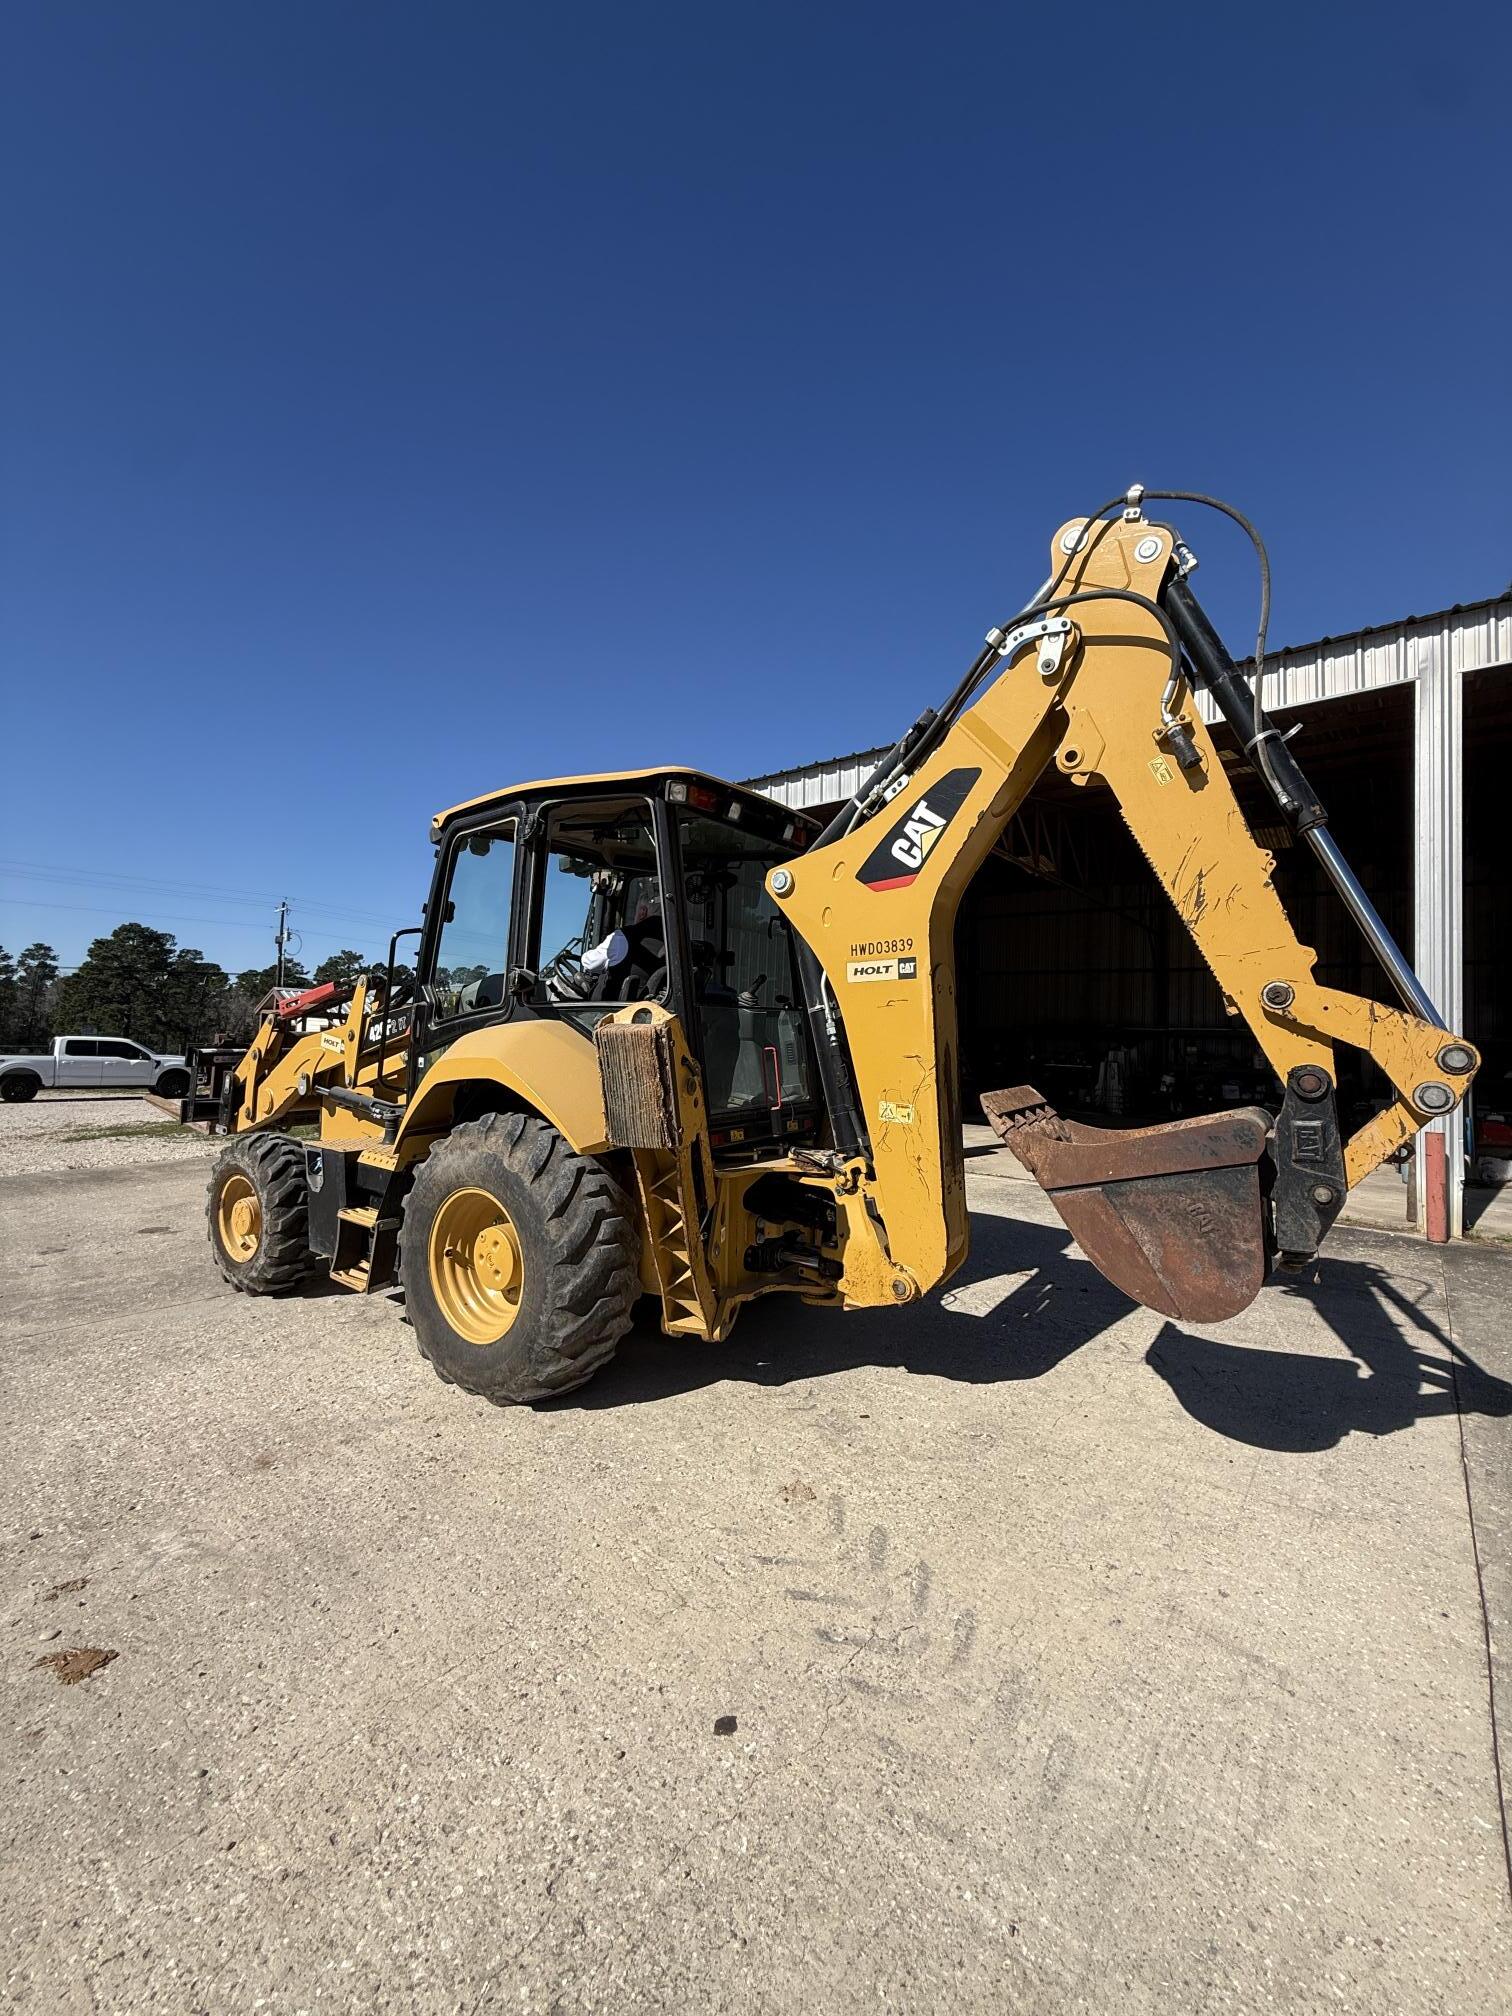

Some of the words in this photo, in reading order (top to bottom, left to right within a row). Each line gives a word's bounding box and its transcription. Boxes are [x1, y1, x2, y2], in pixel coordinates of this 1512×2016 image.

[891, 800, 948, 868] CAT
[851, 938, 913, 956] HWD03839
[854, 965, 893, 976] HOLT
[899, 962, 915, 974] CAT
[323, 1037, 340, 1048] HOLT
